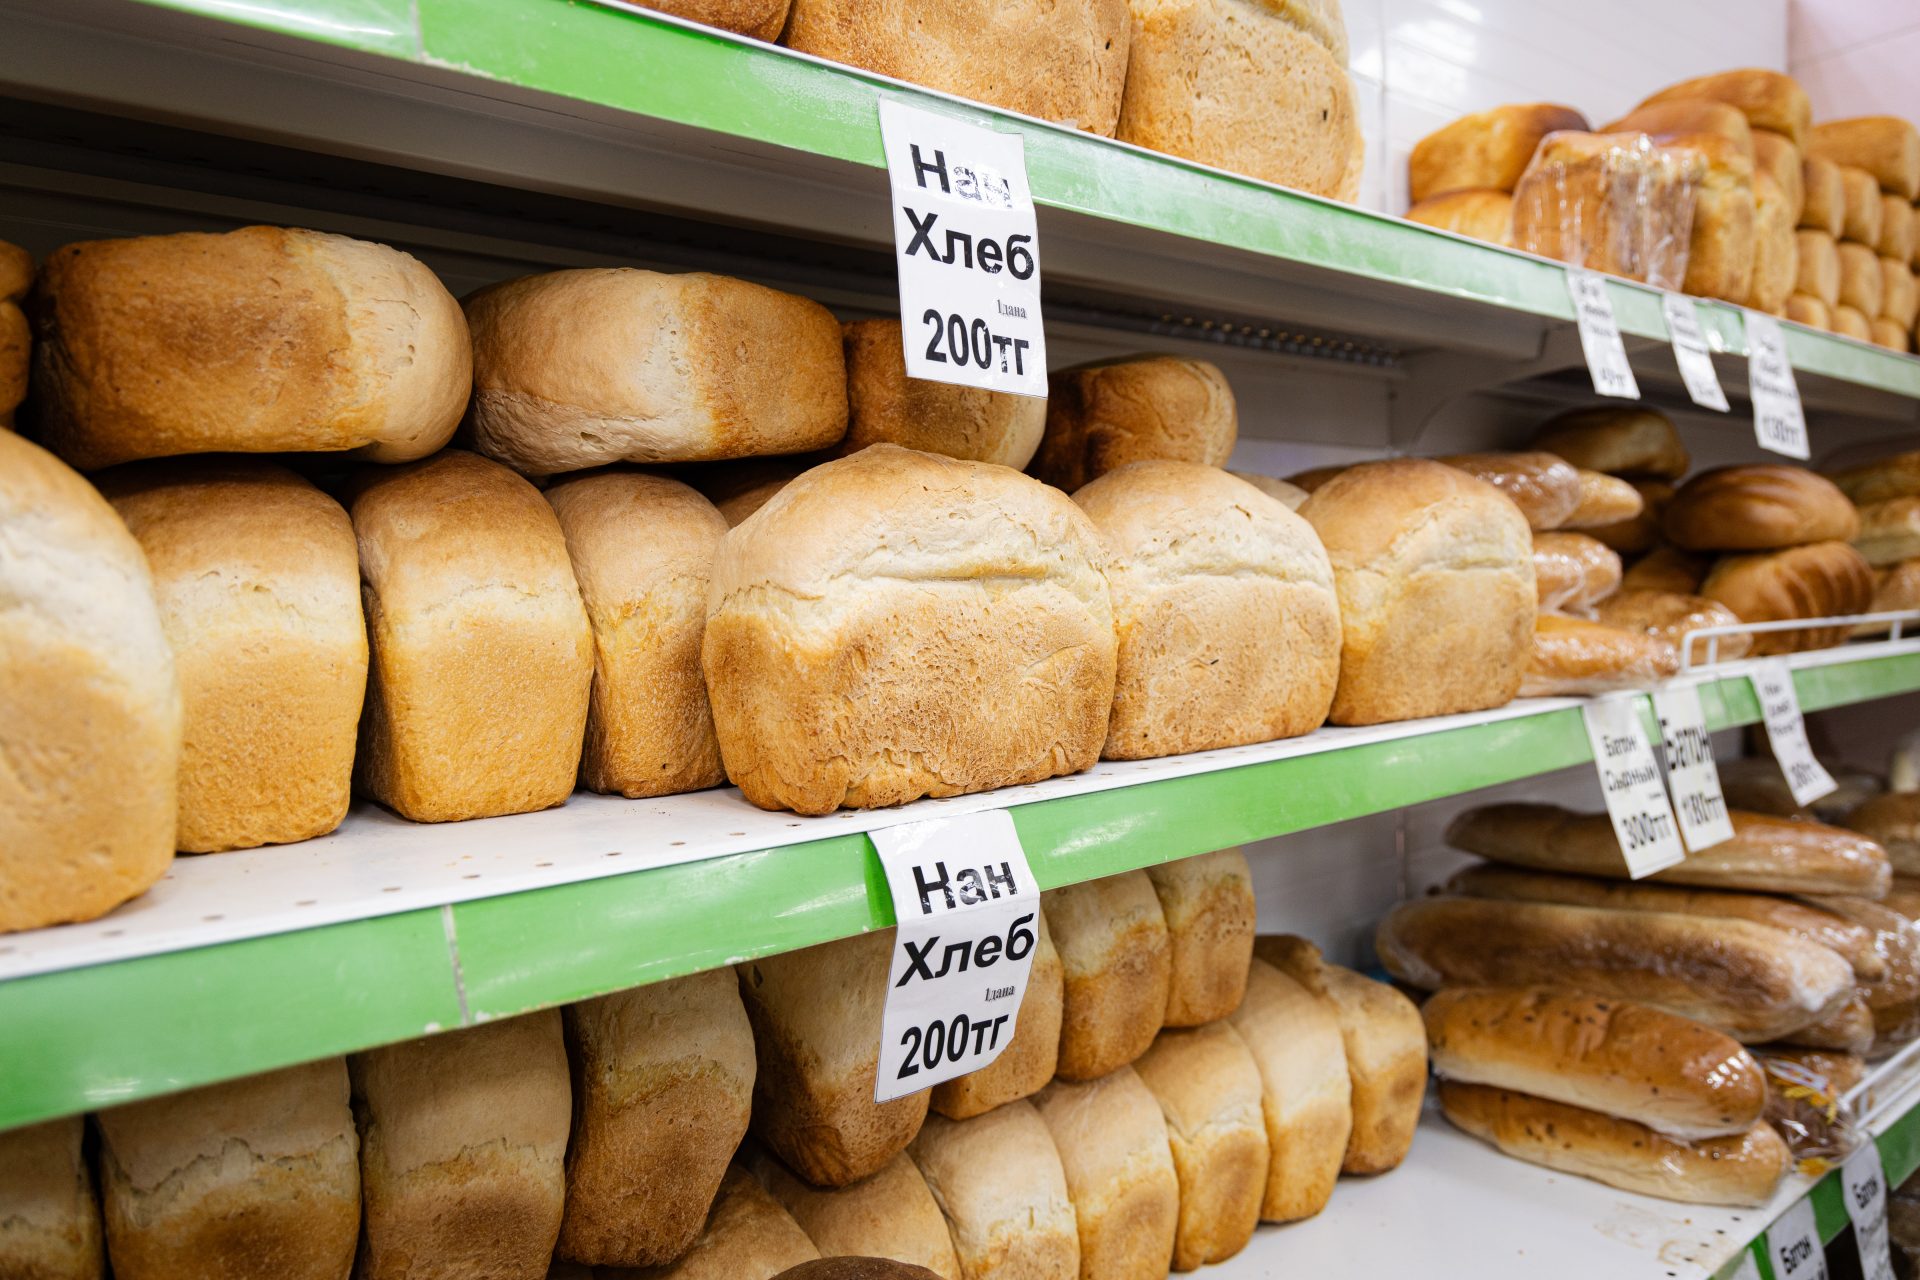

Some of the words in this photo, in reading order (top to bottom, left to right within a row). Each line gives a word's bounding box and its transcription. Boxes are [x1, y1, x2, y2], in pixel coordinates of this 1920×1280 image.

[903, 206, 1035, 280] Хлеб
[923, 308, 1030, 376] 200тг
[912, 861, 1018, 915] Нан
[895, 912, 1035, 988] Хлеб
[984, 983, 1015, 1002] 1дана
[897, 1013, 1010, 1080] 200тг
